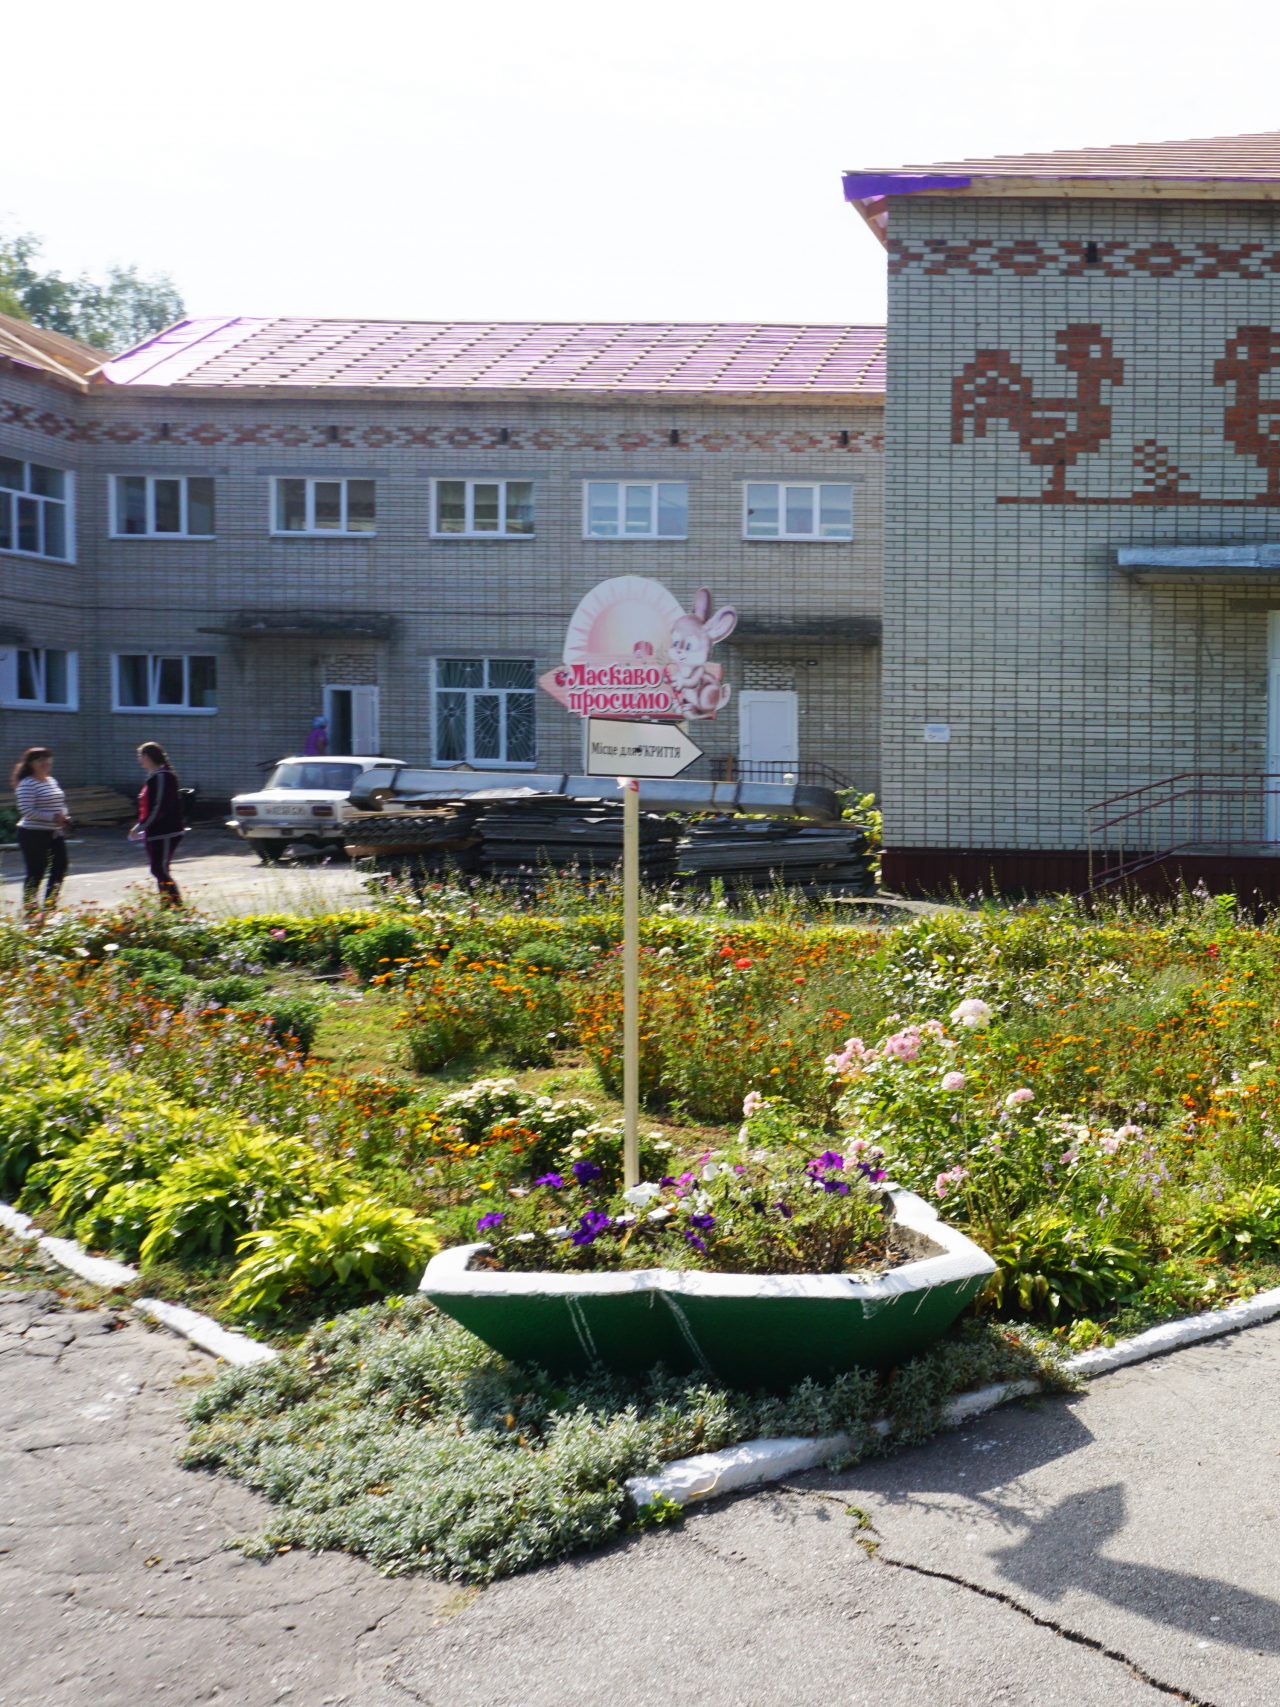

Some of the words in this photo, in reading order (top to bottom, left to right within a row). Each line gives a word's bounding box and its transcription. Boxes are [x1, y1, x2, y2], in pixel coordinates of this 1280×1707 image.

[568, 664, 660, 686] Ласкаво
[569, 689, 669, 715] просимо
[591, 742, 618, 757] Місце
